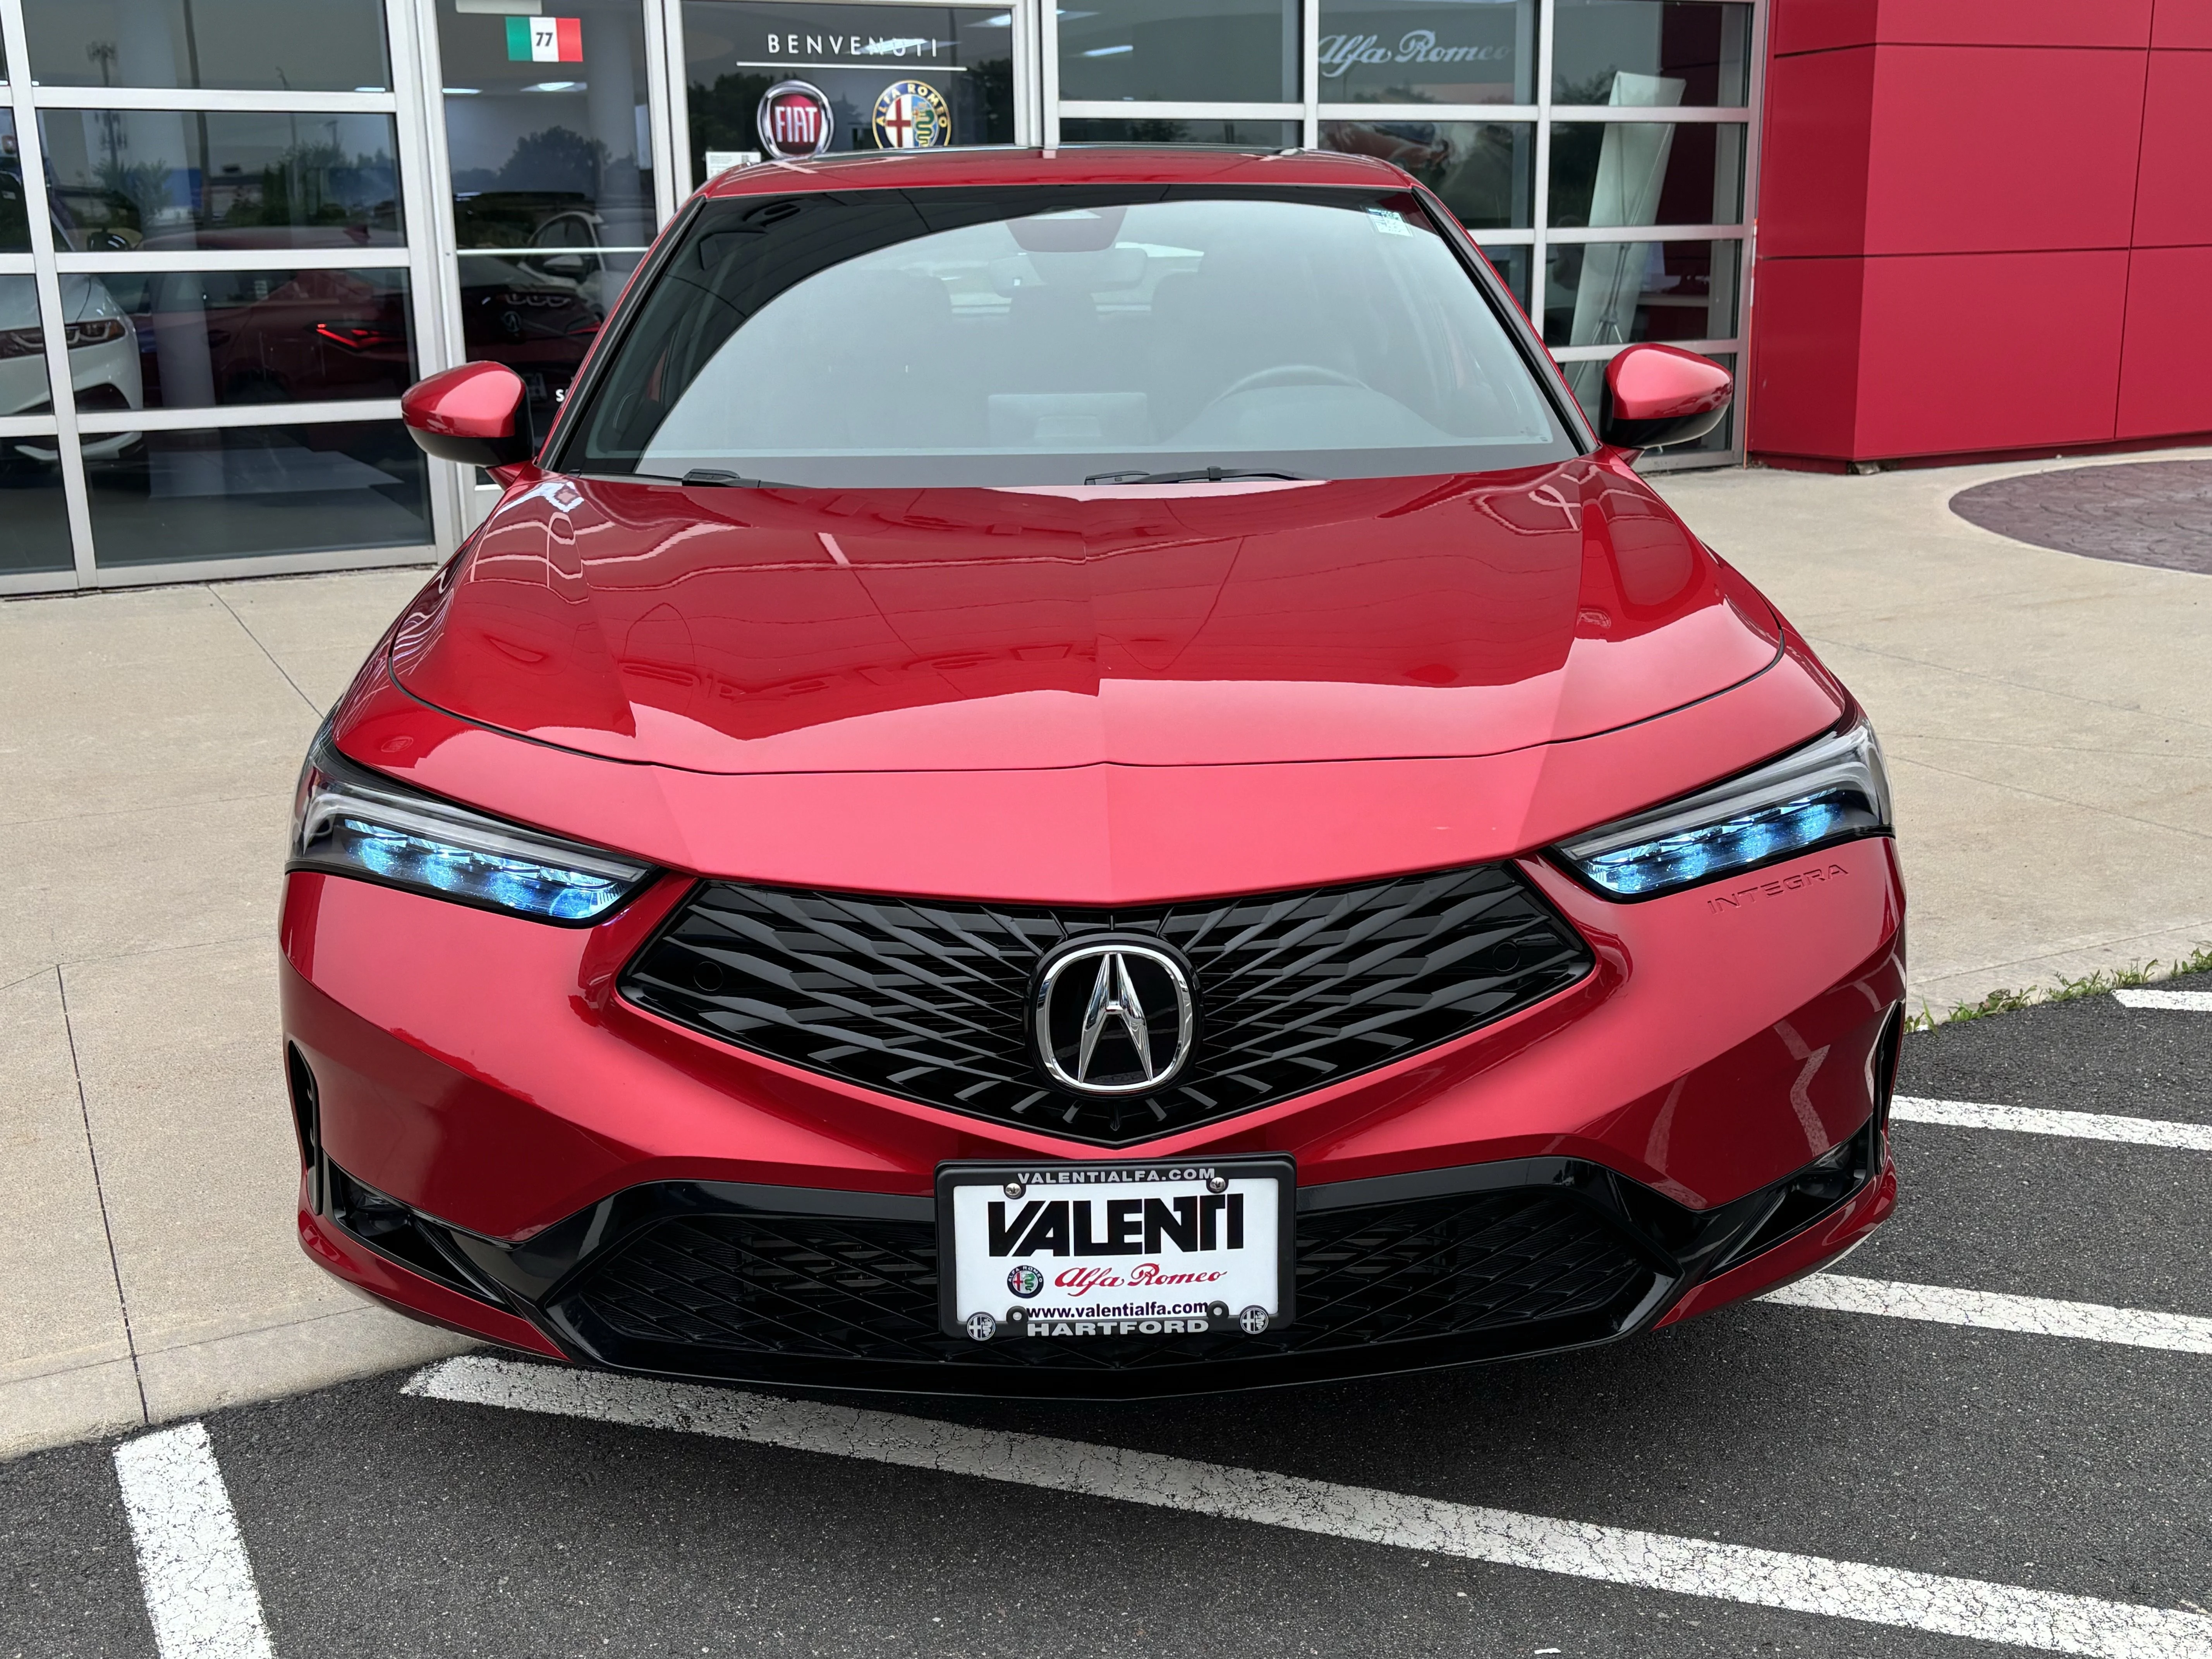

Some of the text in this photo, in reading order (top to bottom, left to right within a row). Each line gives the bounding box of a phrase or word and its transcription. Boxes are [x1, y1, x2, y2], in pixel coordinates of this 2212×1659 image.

[535, 32, 553, 47] 77
[768, 33, 937, 57] BENVENUTI
[1317, 29, 1510, 77] Alfa Romeo
[907, 83, 948, 128] ROMEO
[775, 105, 818, 143] FIAT
[1707, 864, 1849, 915] INTEGRA
[1017, 1168, 1215, 1184] VALENTIALFA.COM
[988, 1193, 1244, 1257] VALENTI
[1008, 1266, 1042, 1283] ALFA ROMEO
[1054, 1262, 1228, 1297] Alfa Romeo
[1026, 1301, 1208, 1318] www.valentialfa.com
[1027, 1319, 1209, 1336] HARTFORD
